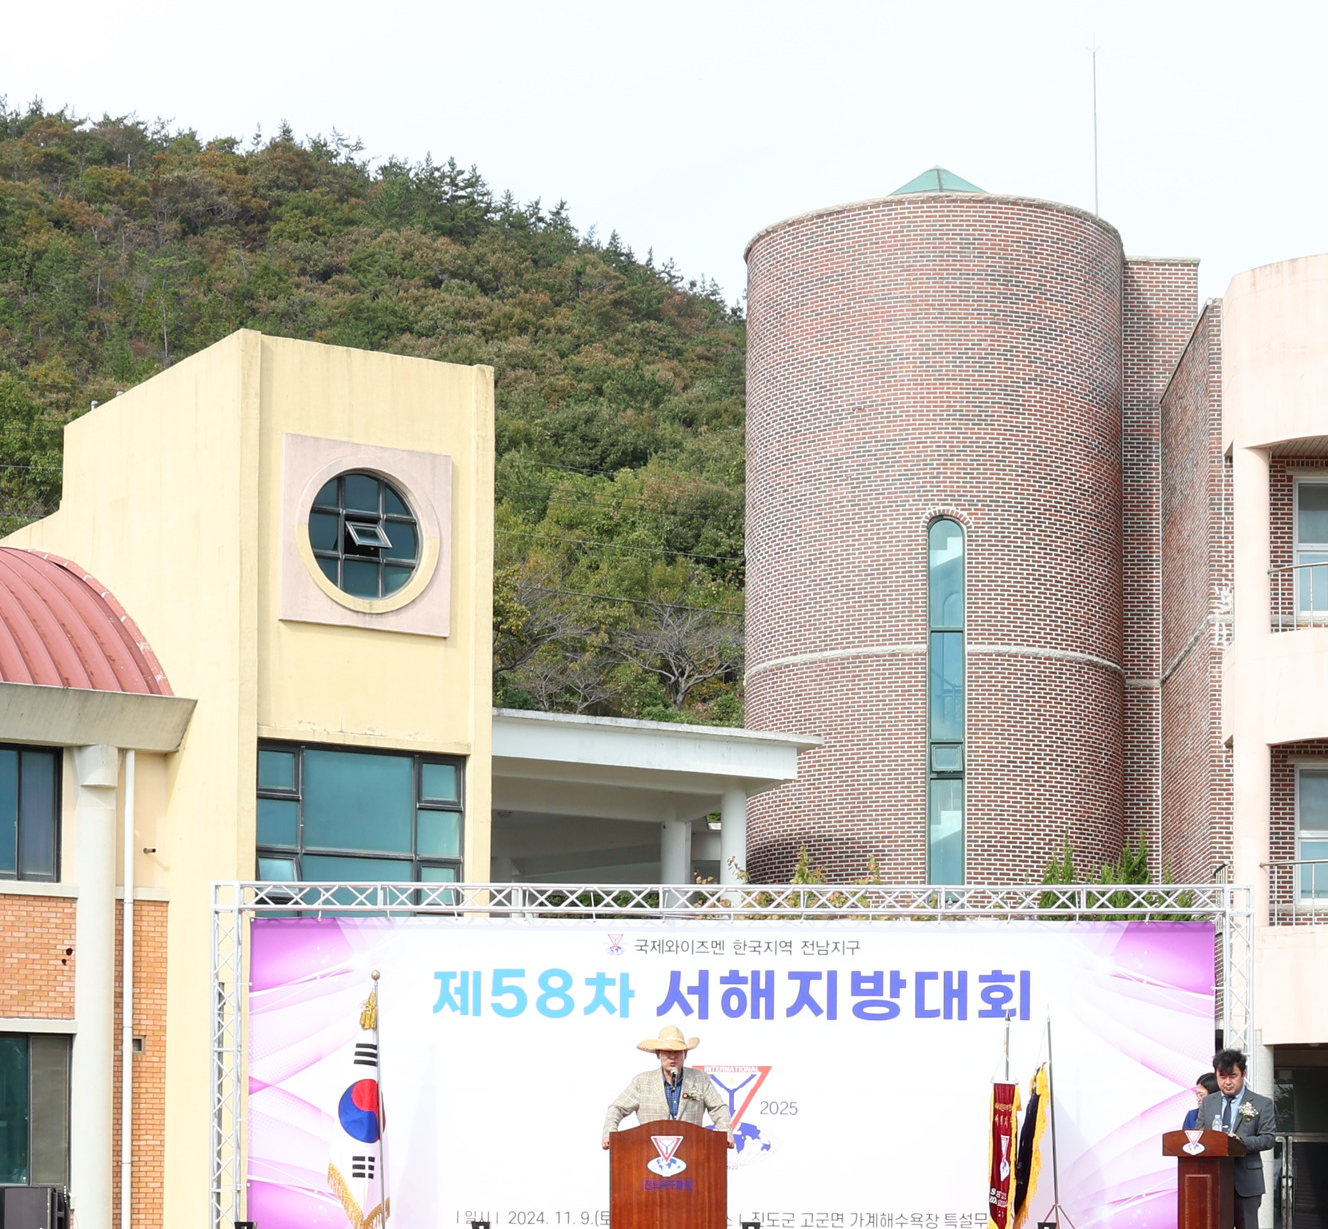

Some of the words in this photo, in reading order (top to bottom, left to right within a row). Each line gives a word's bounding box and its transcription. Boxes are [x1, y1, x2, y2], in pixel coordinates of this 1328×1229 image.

[634, 938, 725, 956] 국제와이즈멘
[732, 938, 793, 956] 한국지역
[800, 938, 862, 956] 전남지구
[432, 968, 635, 1019] 제58차
[656, 969, 1032, 1021] 서해지방대회
[759, 1100, 799, 1115] 2025
[508, 1210, 548, 1225] 2024.
[752, 1212, 795, 1228] 진도군
[800, 1212, 845, 1228] 고군면
[850, 1212, 939, 1229] 가계해수욕장
[943, 1212, 988, 1229] 특설무
